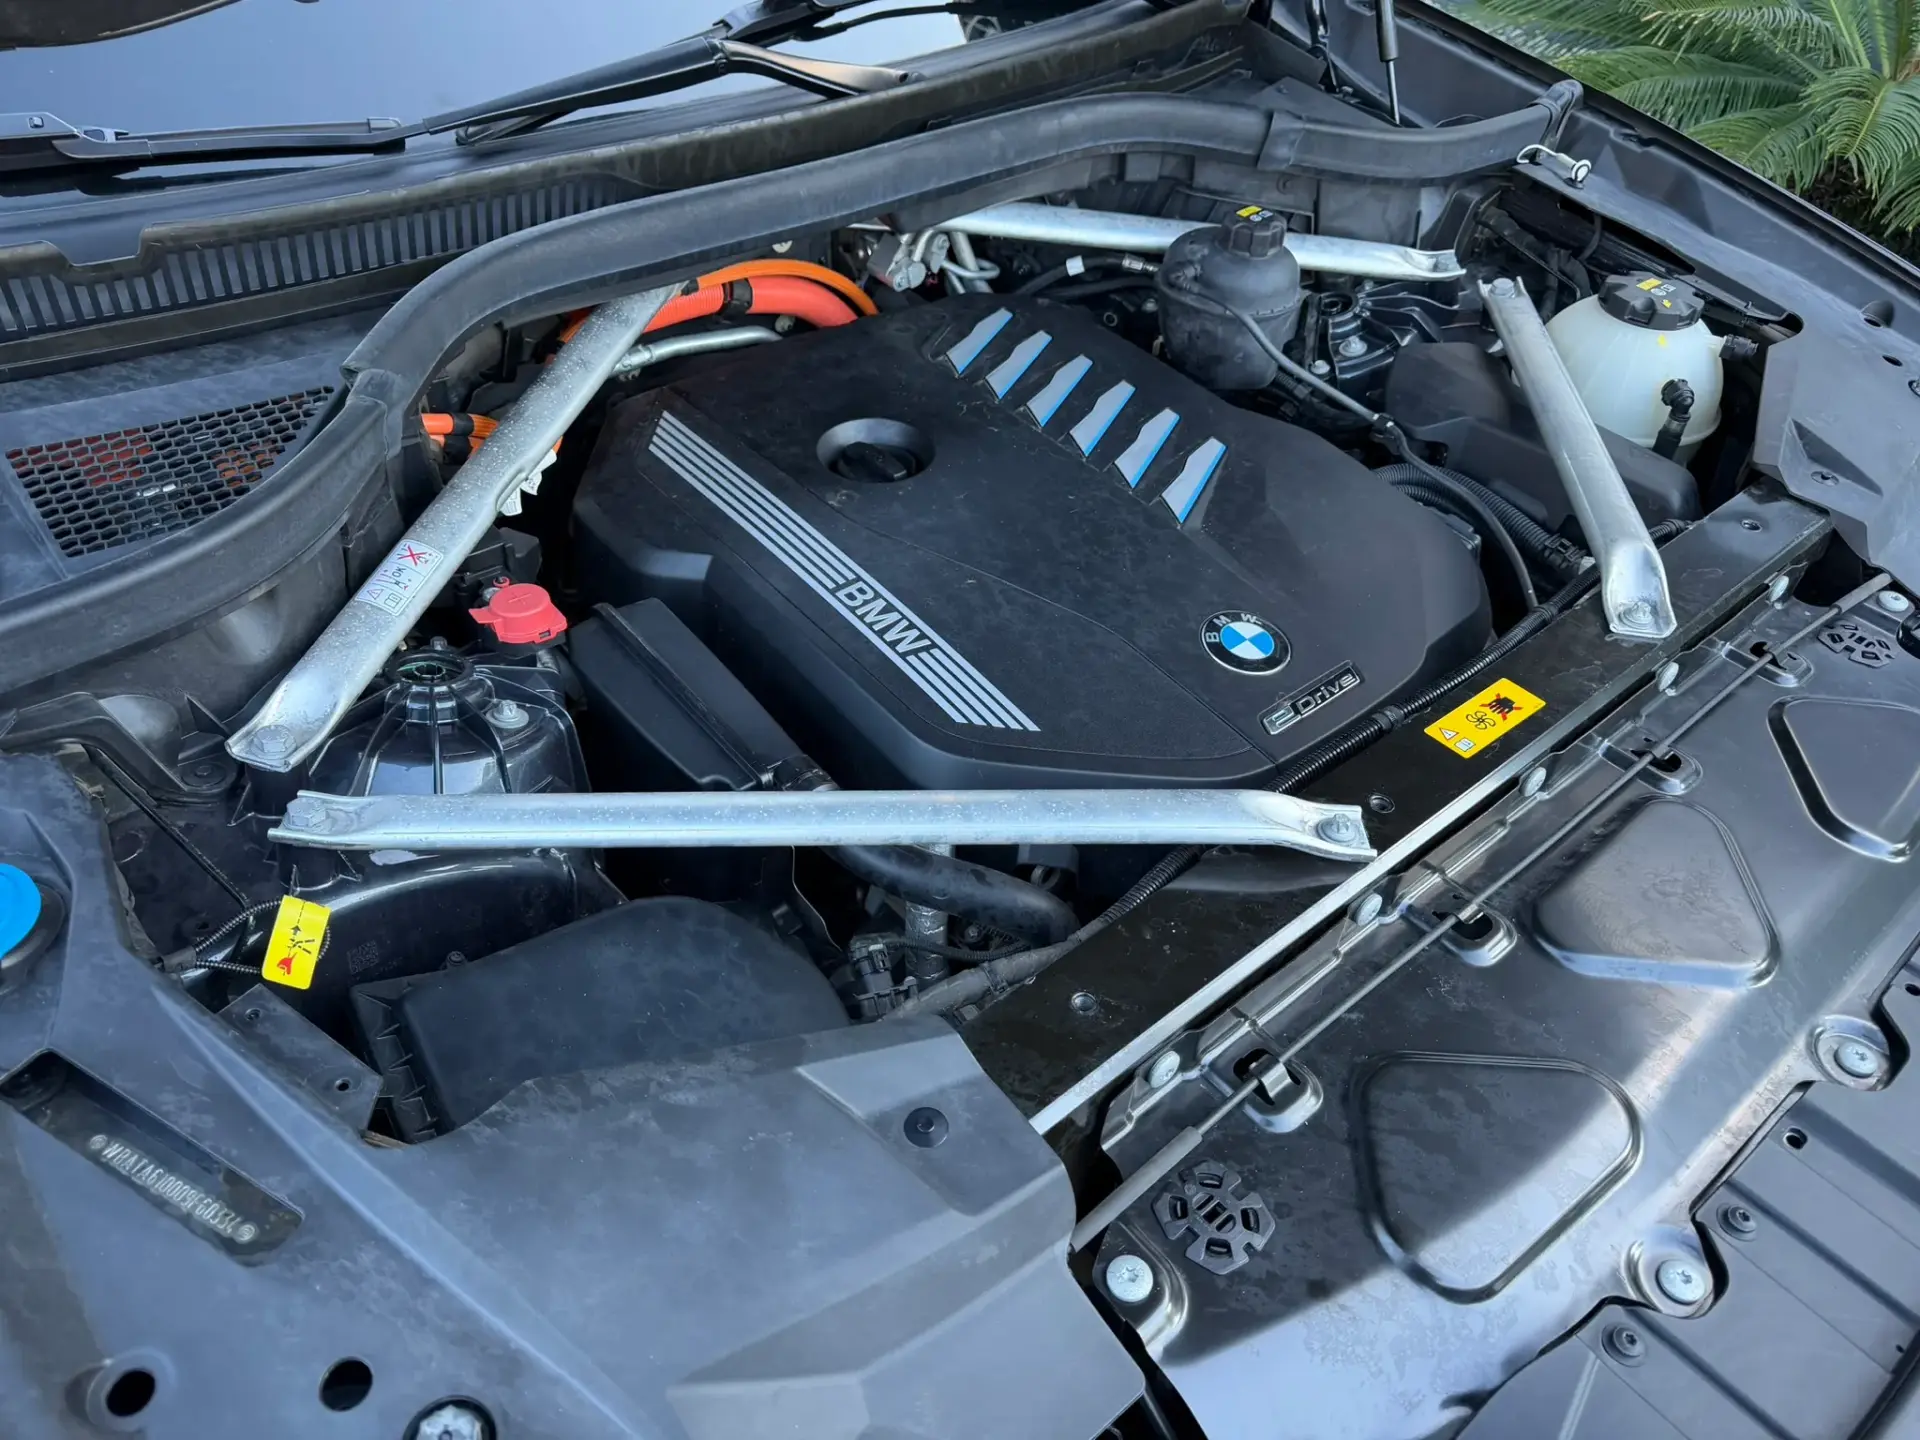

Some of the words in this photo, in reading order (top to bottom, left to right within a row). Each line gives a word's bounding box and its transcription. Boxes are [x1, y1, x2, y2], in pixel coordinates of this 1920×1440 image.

[391, 566, 406, 578] OK
[835, 581, 932, 653] BMW
[1206, 613, 1258, 643] BMW
